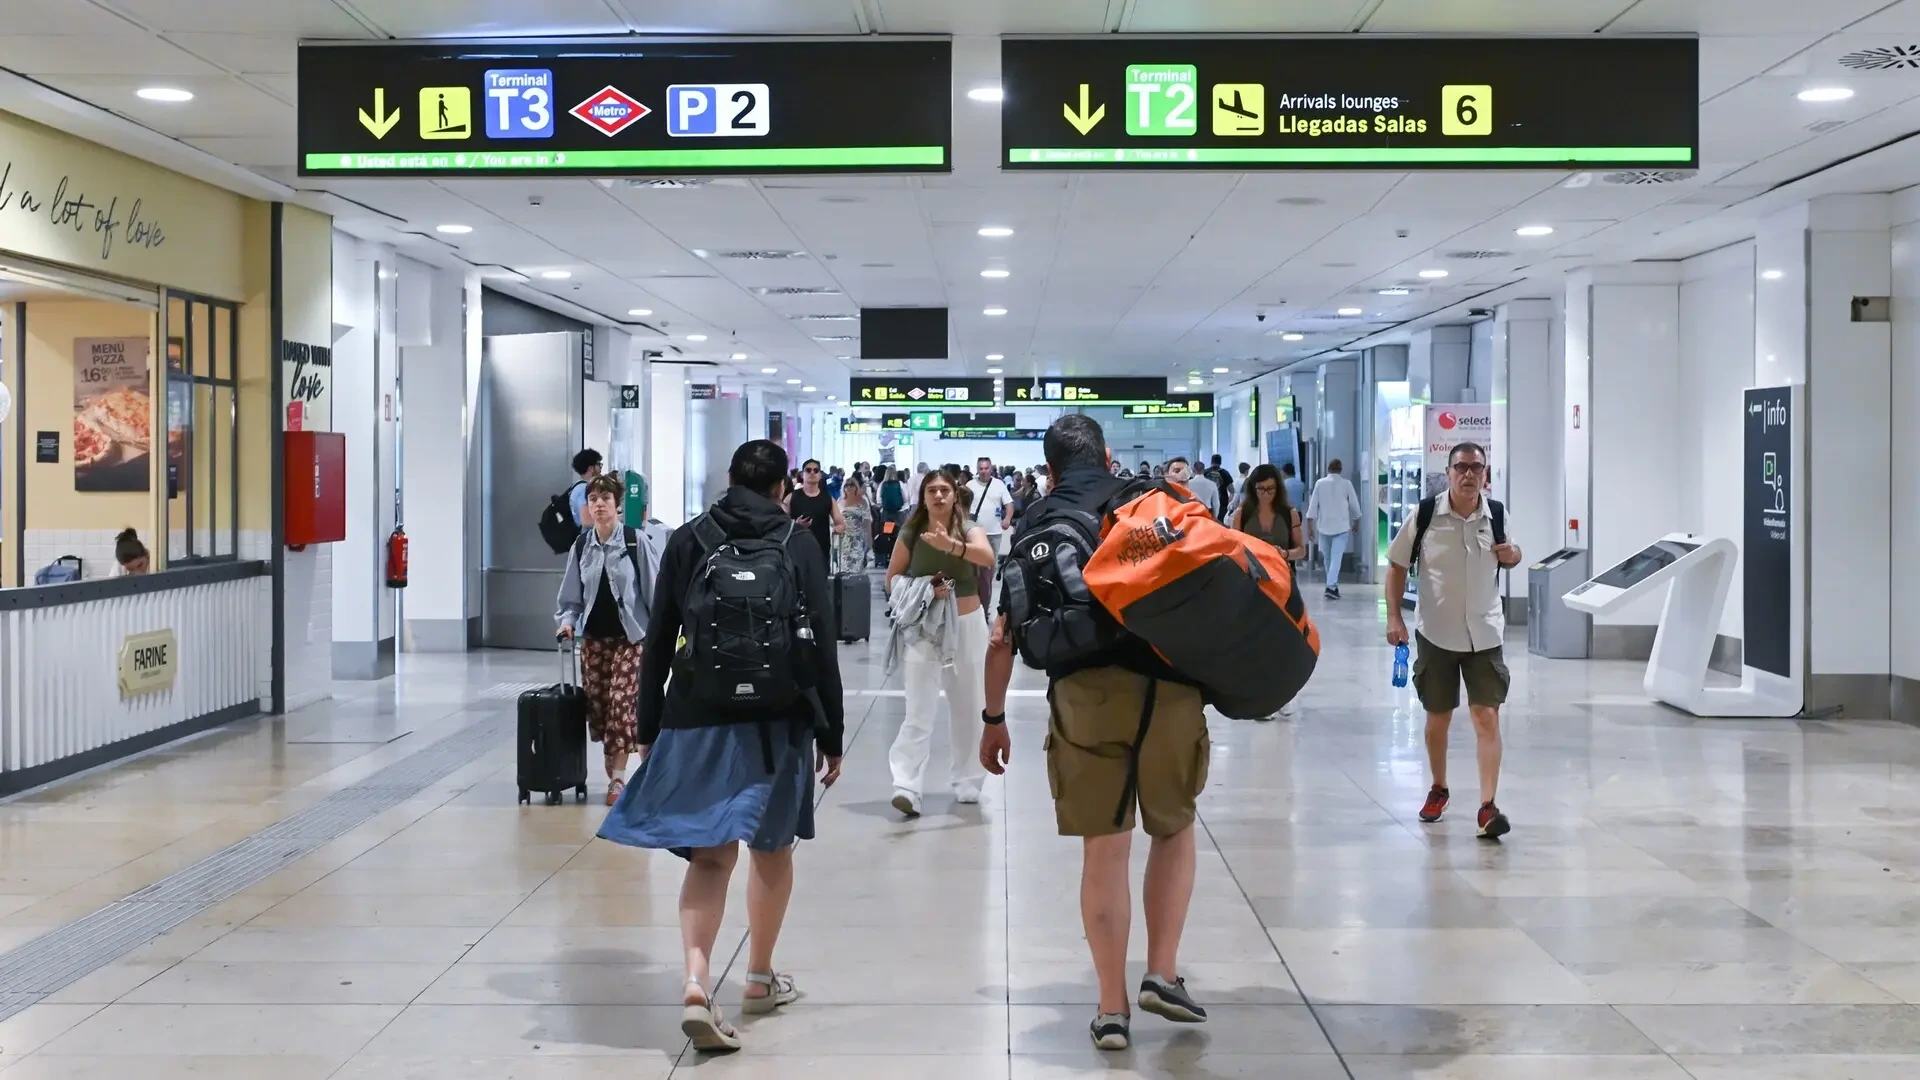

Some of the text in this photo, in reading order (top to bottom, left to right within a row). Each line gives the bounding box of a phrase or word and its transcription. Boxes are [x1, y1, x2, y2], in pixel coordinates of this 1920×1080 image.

[490, 74, 547, 87] Terminal
[1132, 69, 1191, 82] Terminal
[488, 88, 550, 131] T3
[594, 105, 627, 116] Metro
[679, 90, 756, 131] P 2
[1128, 83, 1194, 128] T2
[1279, 94, 1399, 112] Arrivals lounges
[1456, 95, 1478, 126] 6
[1279, 115, 1427, 137] Llegadas Salas
[357, 155, 395, 168] Usted
[432, 157, 449, 168] en
[482, 154, 507, 166] You
[510, 156, 533, 166] are
[536, 153, 549, 166] in
[20, 190, 42, 212] a
[50, 175, 95, 232] lot
[94, 196, 120, 260] of
[126, 198, 165, 249] love
[92, 353, 125, 365] PIZZA
[310, 345, 331, 368] WITH
[290, 359, 325, 402] love
[1767, 399, 1787, 426] info
[134, 643, 167, 672] FARINE
